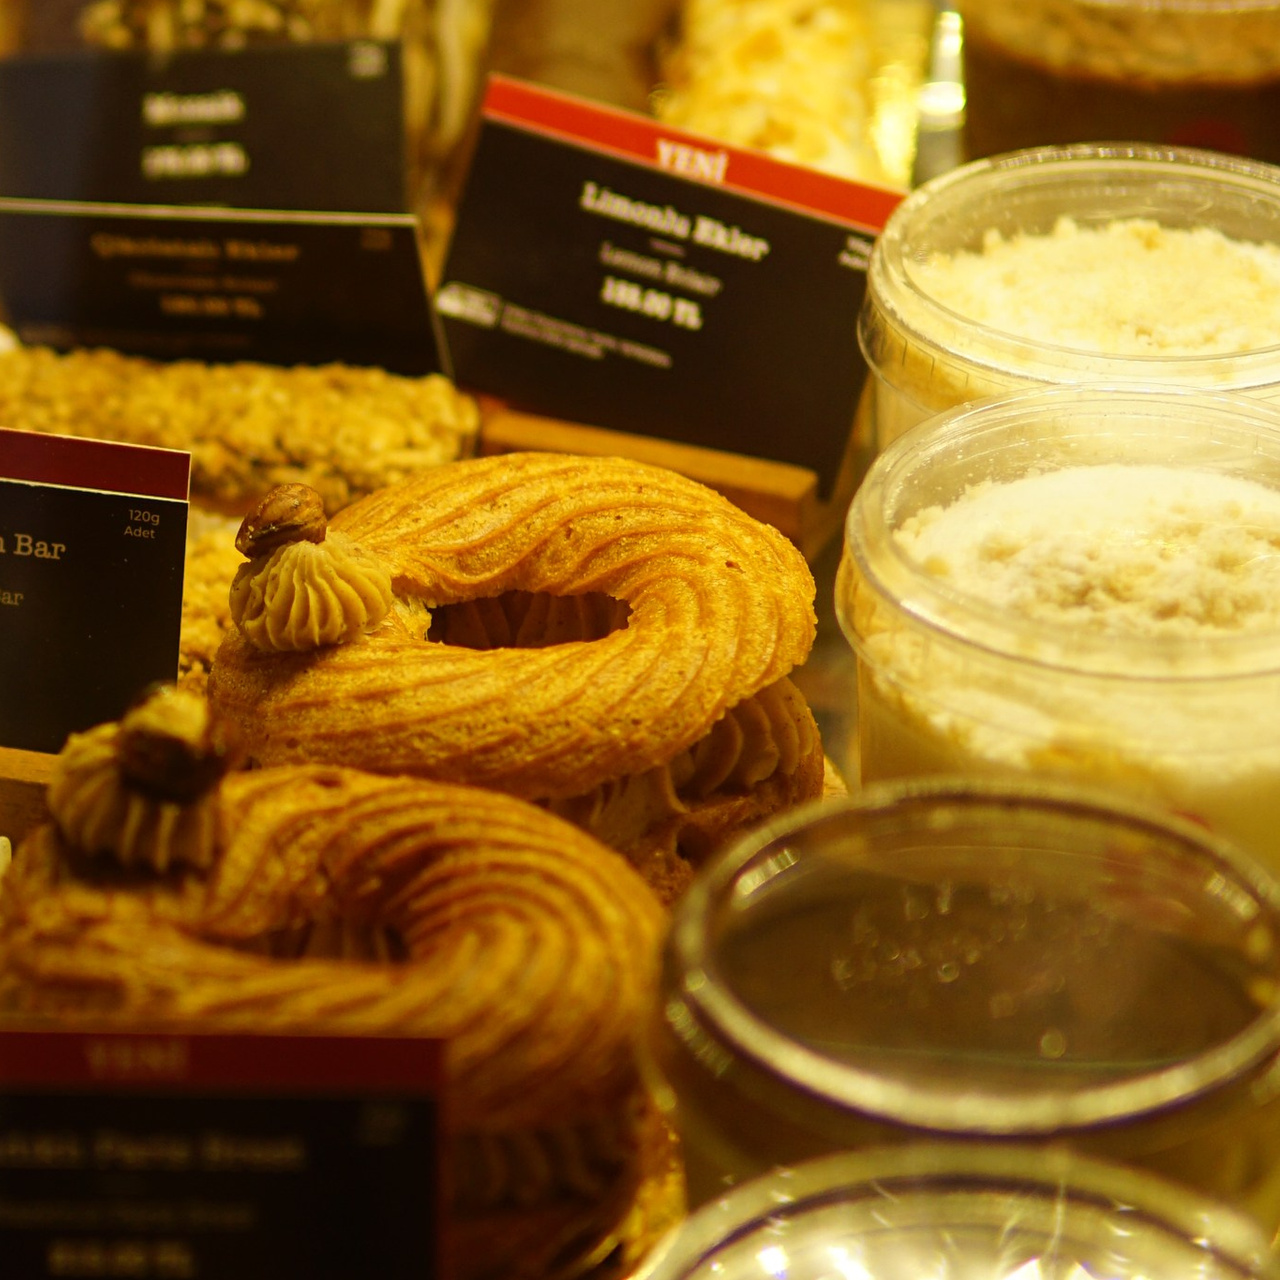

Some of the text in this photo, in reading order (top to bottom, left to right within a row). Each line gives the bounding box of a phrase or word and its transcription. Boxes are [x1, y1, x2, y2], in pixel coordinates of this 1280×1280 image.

[128, 509, 160, 526] 120g
[123, 525, 156, 539] Adet
[13, 533, 67, 560] Bar
